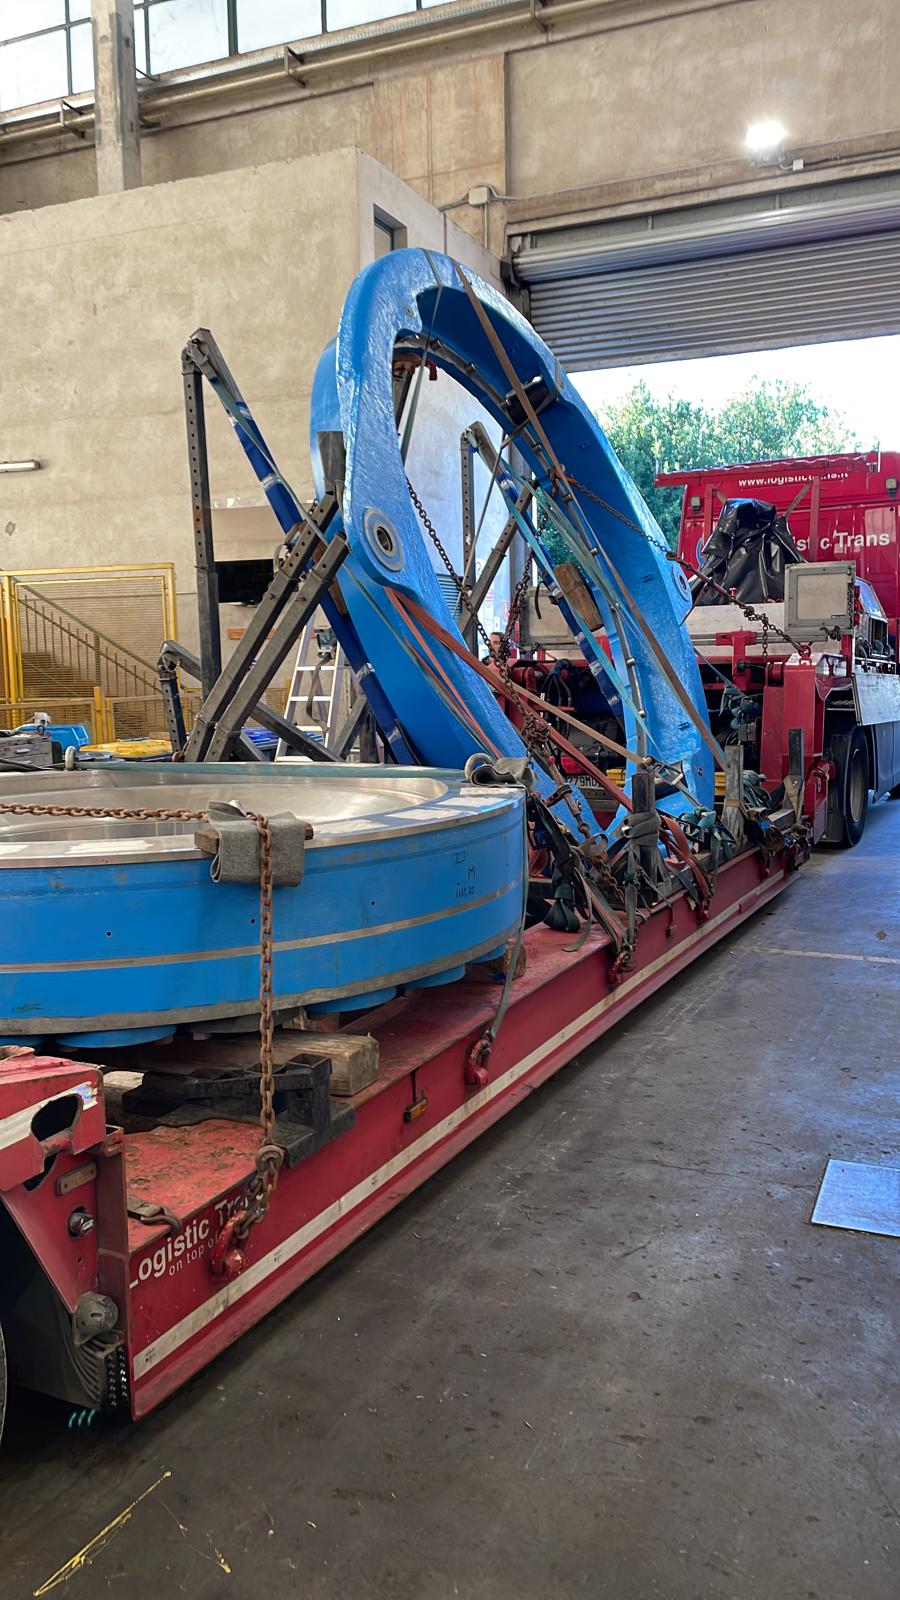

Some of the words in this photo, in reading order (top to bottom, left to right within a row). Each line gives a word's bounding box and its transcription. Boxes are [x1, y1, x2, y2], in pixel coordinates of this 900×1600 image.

[835, 532, 890, 548] Trans
[169, 1259, 183, 1276] on
[186, 1244, 204, 1265] top
